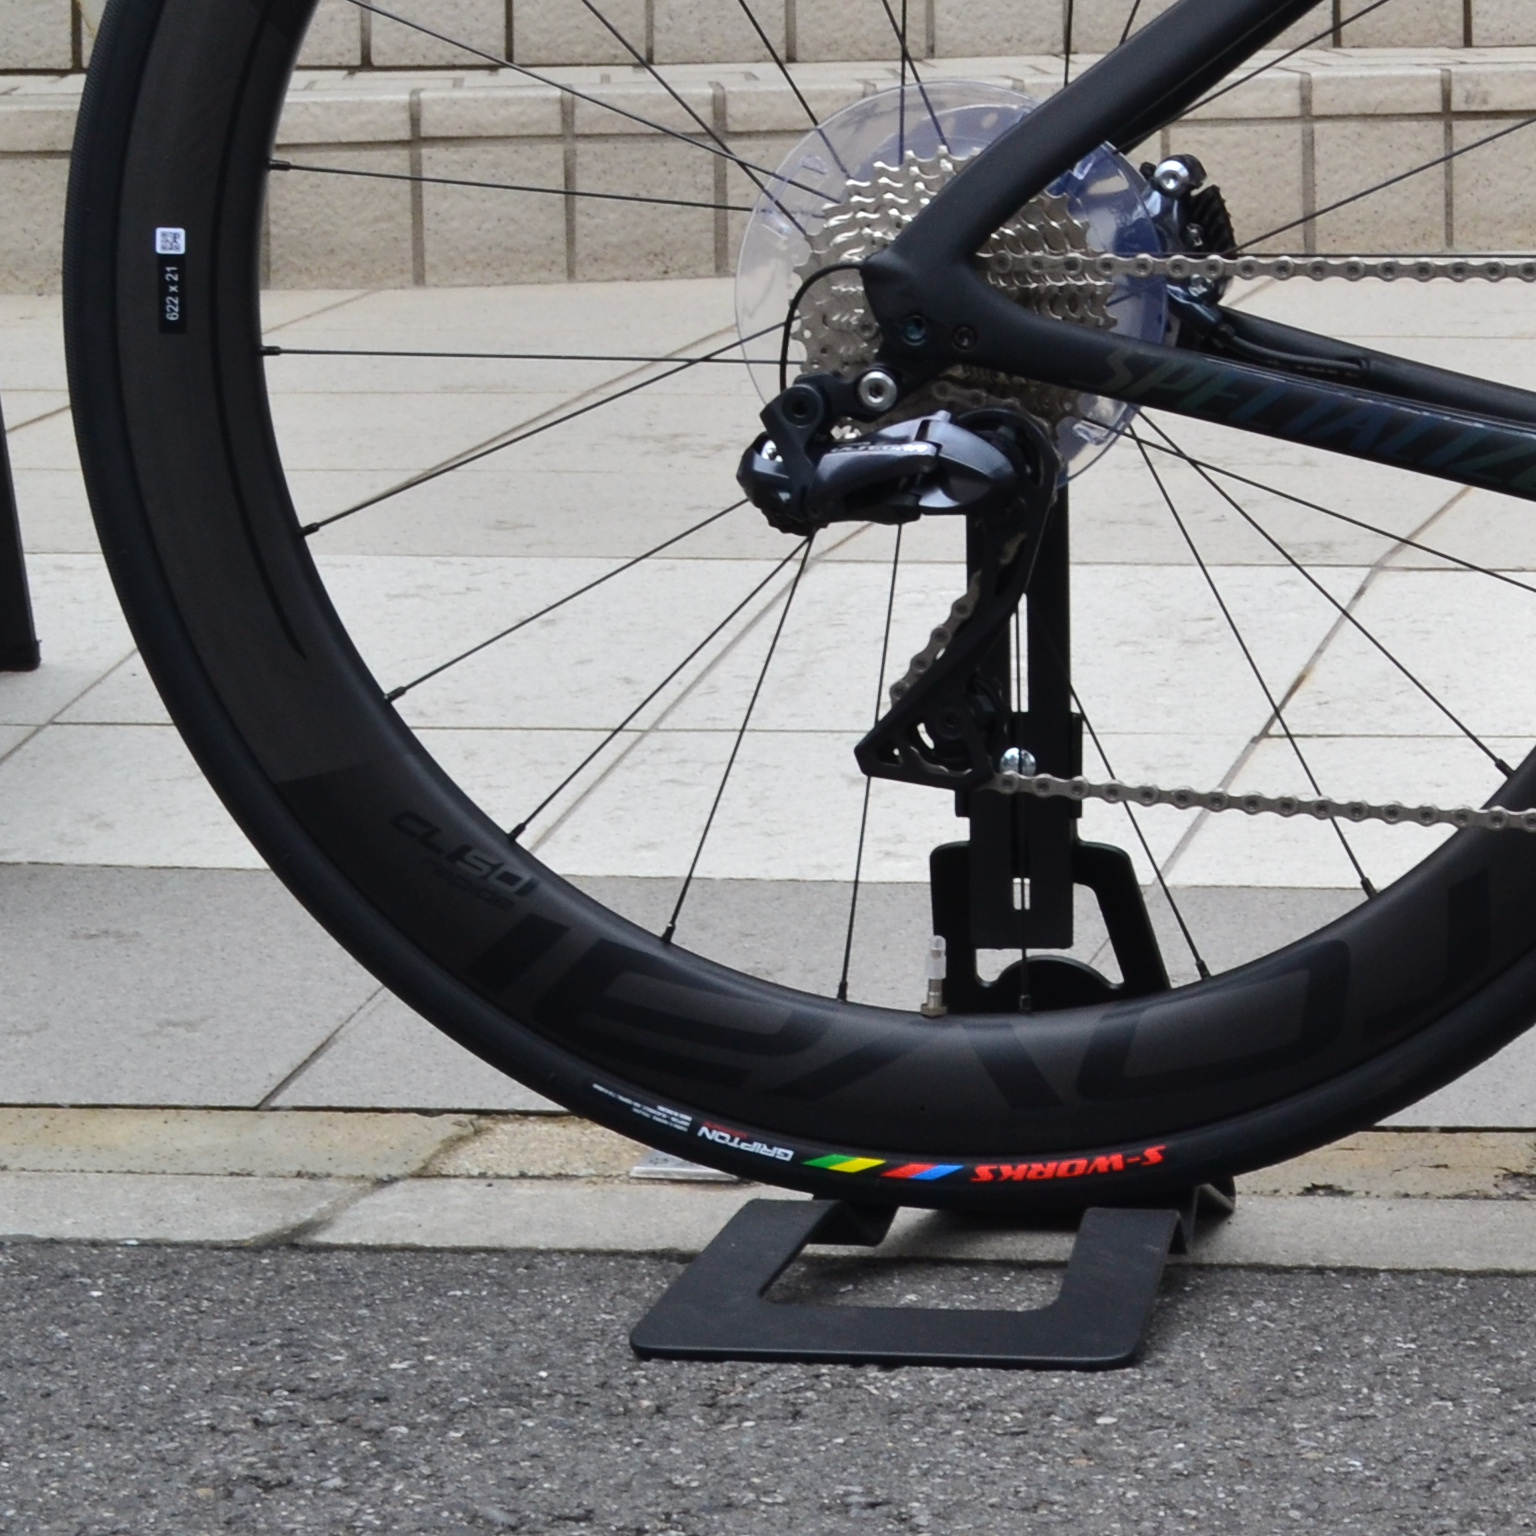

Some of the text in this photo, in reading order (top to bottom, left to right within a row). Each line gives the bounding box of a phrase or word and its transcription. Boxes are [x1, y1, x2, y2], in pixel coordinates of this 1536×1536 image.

[165, 265, 179, 281] 21
[165, 295, 179, 321] 622
[697, 1125, 795, 1162] GRIPTON
[970, 1144, 1168, 1183] S-WORKS
